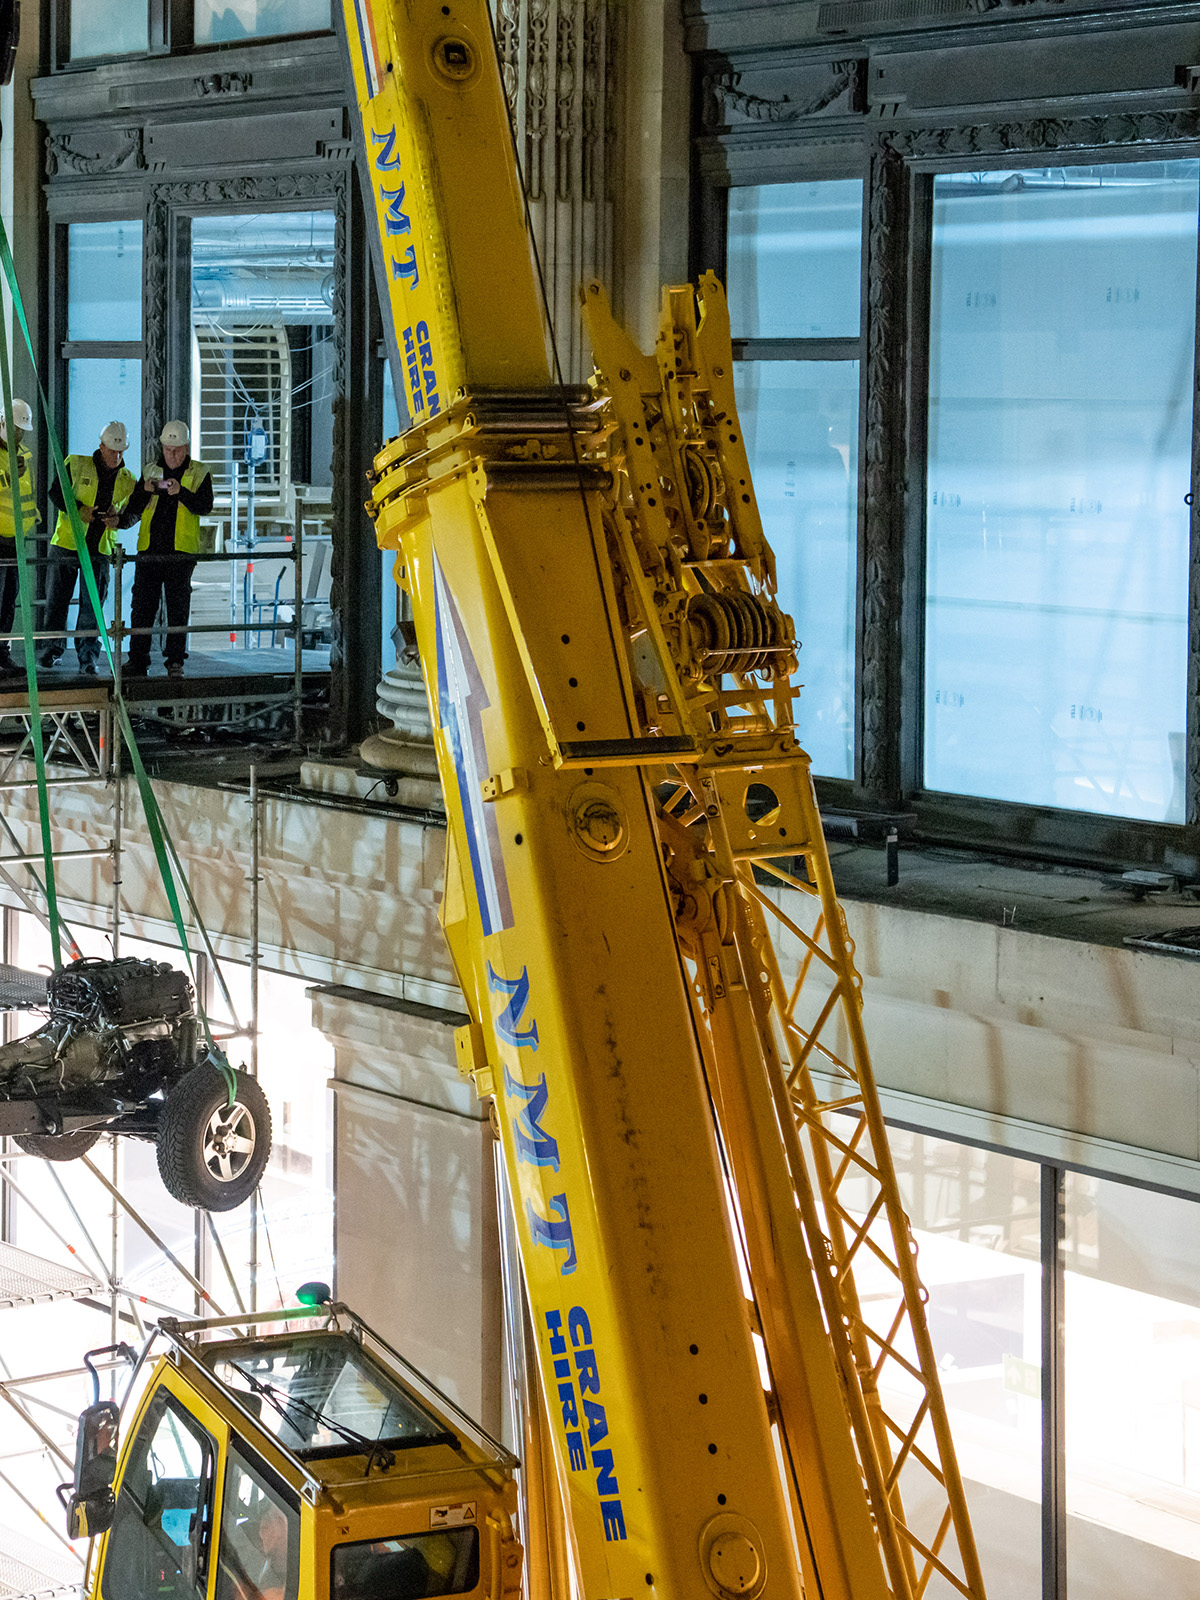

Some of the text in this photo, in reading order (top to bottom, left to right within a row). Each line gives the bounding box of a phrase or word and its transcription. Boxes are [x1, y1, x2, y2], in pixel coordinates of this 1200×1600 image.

[371, 123, 420, 291] NMT
[402, 326, 425, 414] HIRE
[486, 959, 577, 1276] NMT
[545, 1309, 587, 1472] HIRE
[568, 1306, 628, 1542] CRANE
